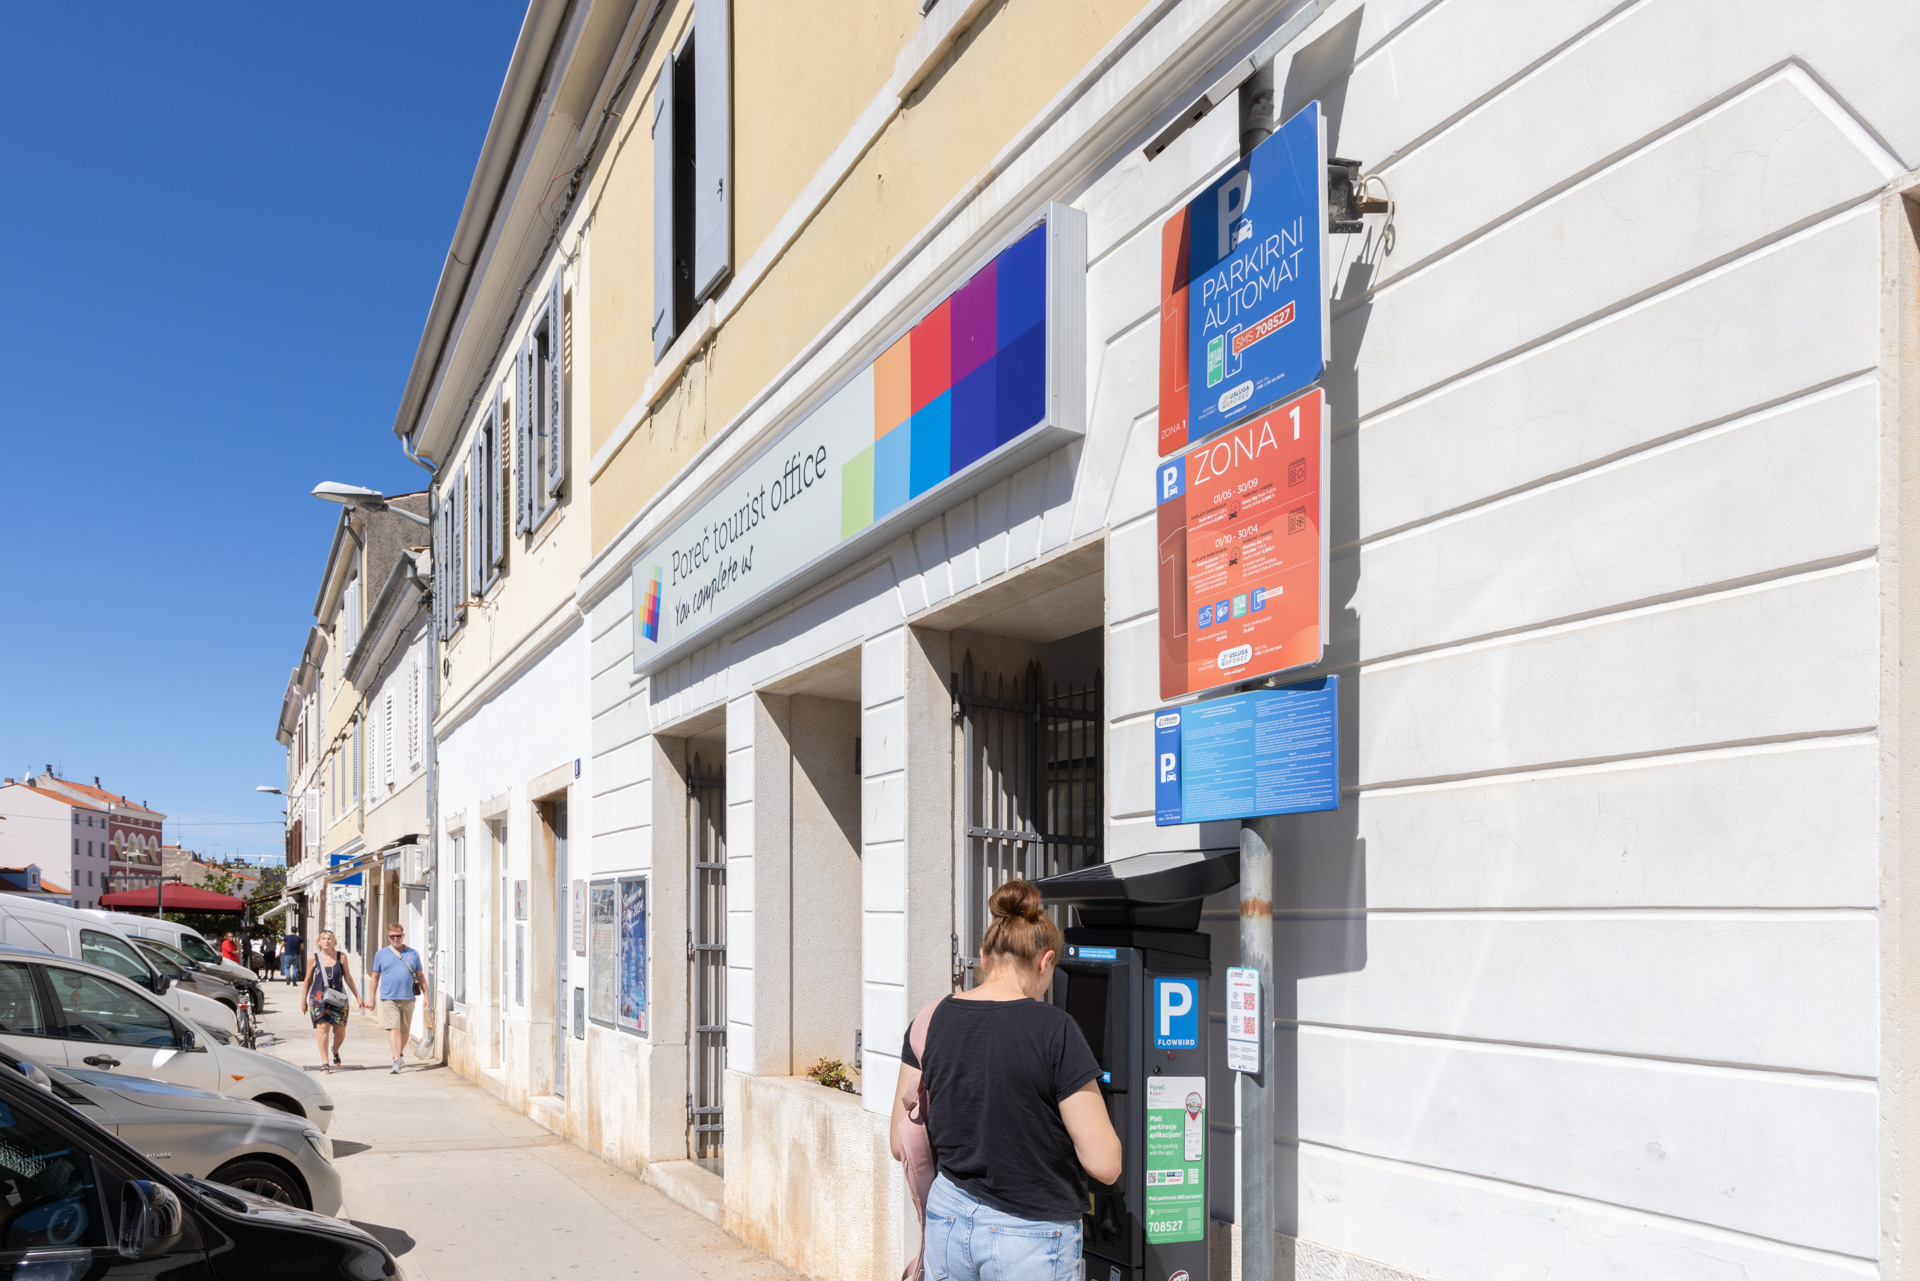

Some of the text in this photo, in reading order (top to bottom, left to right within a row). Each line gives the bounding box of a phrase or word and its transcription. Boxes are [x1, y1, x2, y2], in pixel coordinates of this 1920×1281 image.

[1217, 169, 1252, 260] P
[1203, 215, 1304, 307] PARKIRNI
[1202, 247, 1304, 336] AUTOMAT
[1236, 308, 1291, 349] SMS 708527
[1229, 384, 1249, 399] USLUGA
[1229, 391, 1249, 405] POREČ
[1161, 419, 1186, 440] ZONA 1
[1194, 405, 1300, 486] ZONA 1
[1163, 465, 1178, 499] P
[1213, 489, 1231, 504] 01/05
[1237, 477, 1257, 494] 30/09
[672, 444, 827, 587] Poreč tourist office
[1214, 533, 1232, 548] 01/10
[1237, 523, 1257, 539] 30/04
[675, 544, 754, 627] You complete us
[1266, 588, 1281, 597] 708527
[1228, 654, 1248, 663] POREČ
[1229, 648, 1248, 657] USLUGA
[1160, 752, 1176, 783] P
[1160, 982, 1192, 1036] P
[1158, 1038, 1195, 1046] FLOWBIRD
[1149, 1123, 1177, 1132] parkiranje
[1149, 1131, 1182, 1140] aplikacijom!
[1148, 1220, 1183, 1233] 708527
